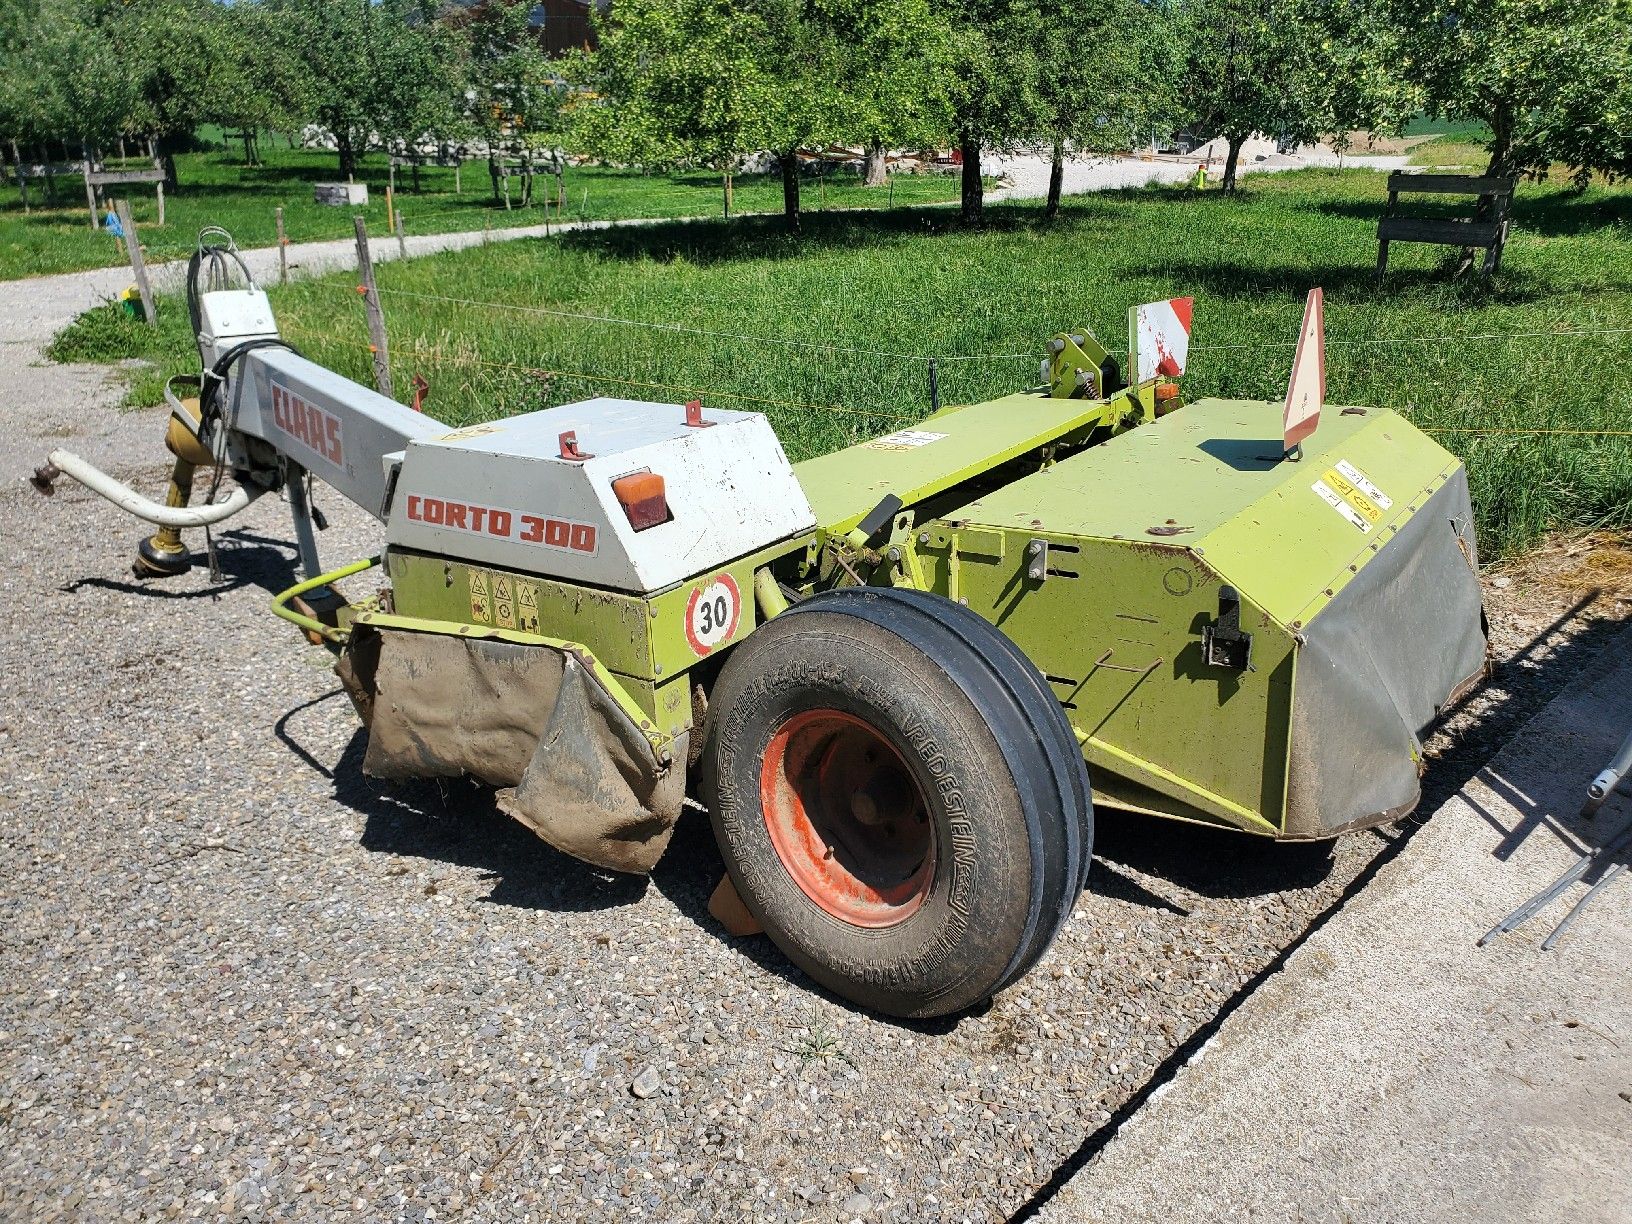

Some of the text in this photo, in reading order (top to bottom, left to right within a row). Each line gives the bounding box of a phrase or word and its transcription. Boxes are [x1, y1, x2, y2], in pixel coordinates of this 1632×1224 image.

[273, 384, 343, 466] CLAAS
[407, 495, 596, 553] CORTO 300
[700, 595, 727, 635] 30
[900, 711, 976, 866] VREDESTEIN
